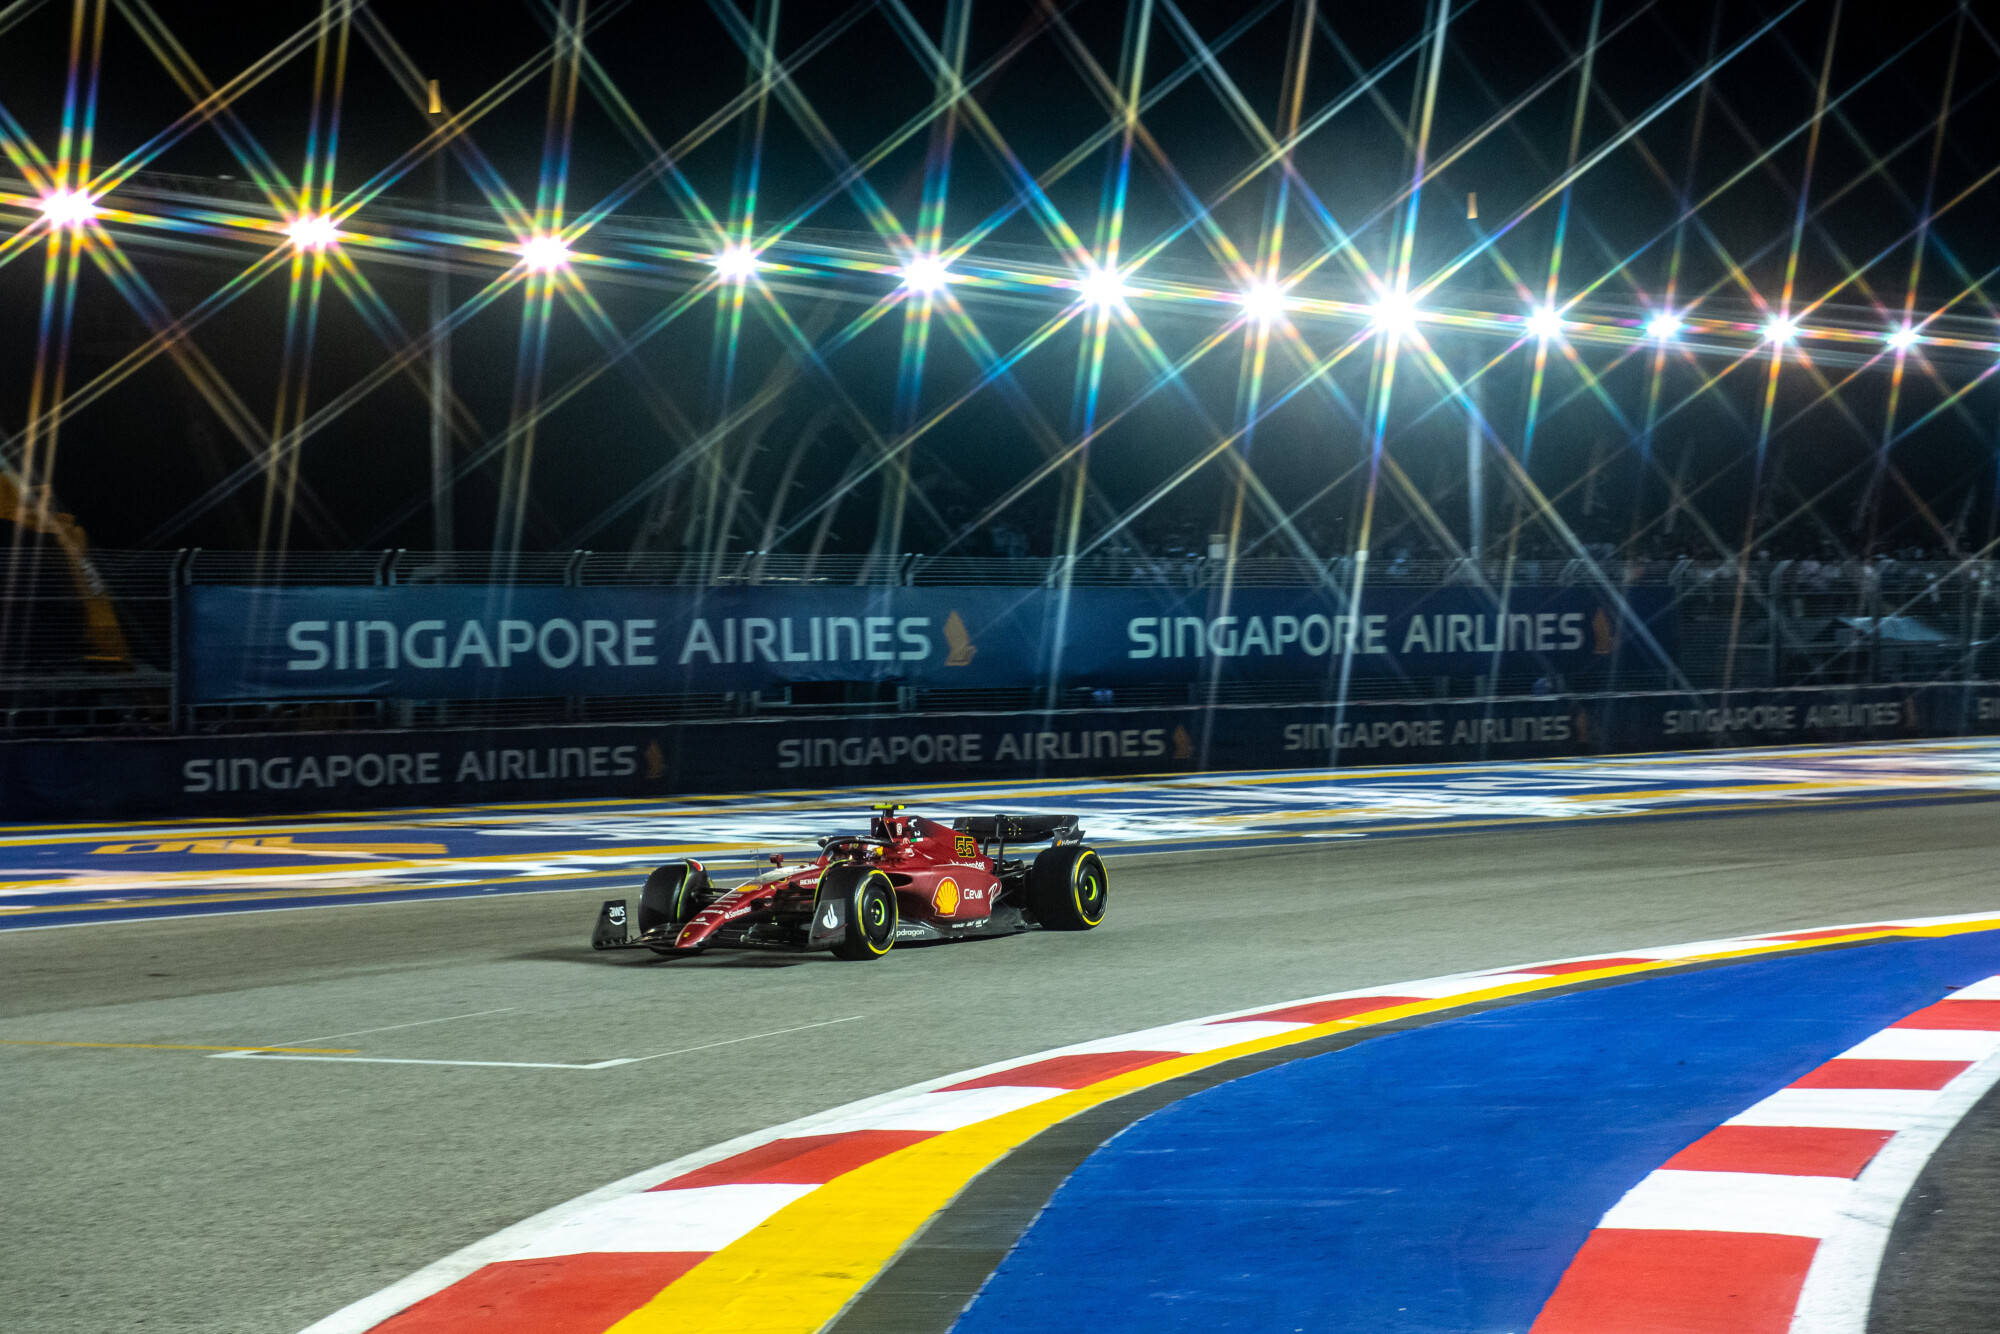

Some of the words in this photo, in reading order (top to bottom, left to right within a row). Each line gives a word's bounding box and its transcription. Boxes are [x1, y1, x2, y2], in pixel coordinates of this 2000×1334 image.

[287, 618, 658, 671] SINGAPORE
[678, 616, 932, 664] AIRLINES
[1128, 613, 1388, 659] SINGAPORE
[1401, 612, 1585, 653] AIRLINES
[1284, 720, 1443, 751] SINGAPORE
[1451, 715, 1571, 744] AIRLINES
[1663, 705, 1797, 734] SINGAPORE
[1804, 702, 1900, 728] AIRLINES
[777, 734, 982, 769] SINGAPORE
[995, 729, 1165, 762] AIRLINES
[183, 752, 441, 792] SINGAPORE
[455, 745, 637, 782] AIRLINES
[955, 836, 976, 858] 55
[800, 878, 820, 886] RICHAR
[896, 929, 925, 938] pdragon
